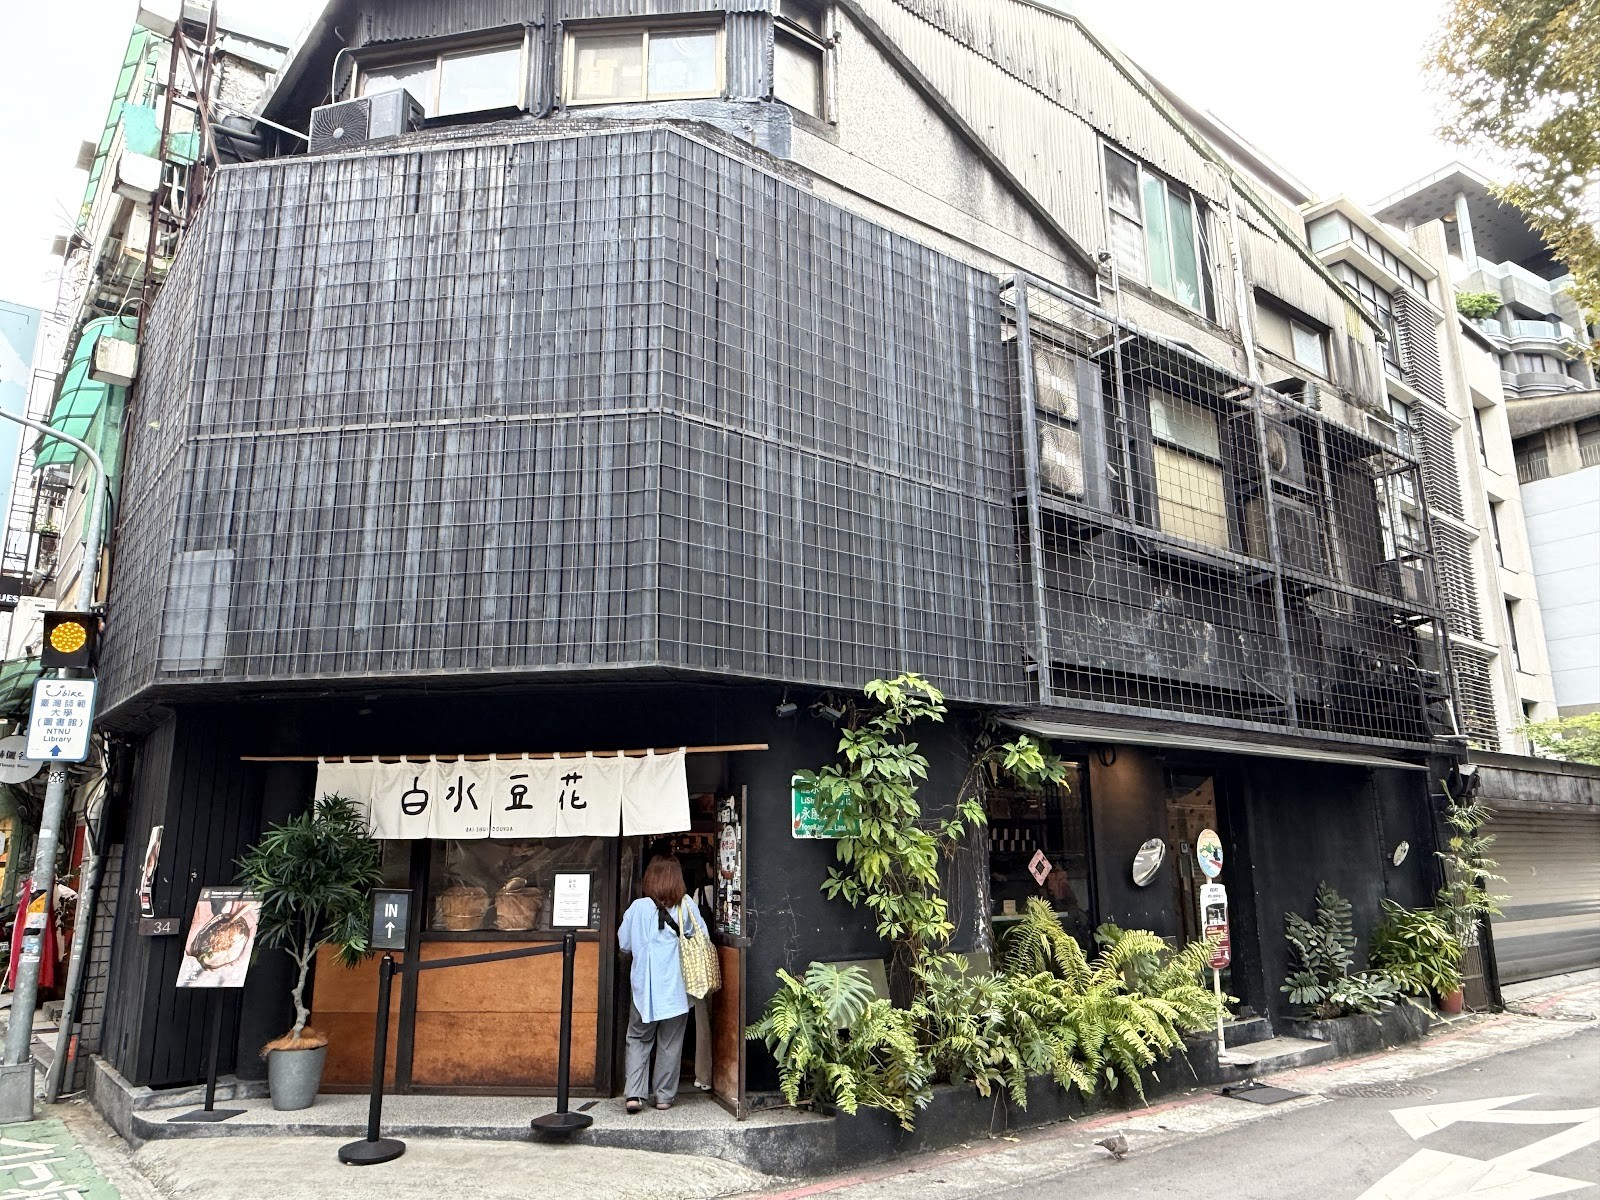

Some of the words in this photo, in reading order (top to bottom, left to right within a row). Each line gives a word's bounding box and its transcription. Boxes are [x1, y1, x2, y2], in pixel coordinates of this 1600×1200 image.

[50, 709, 73, 717] 大學
[401, 772, 587, 816] 白水豆花
[384, 903, 398, 918] IN
[153, 921, 171, 934] 34
